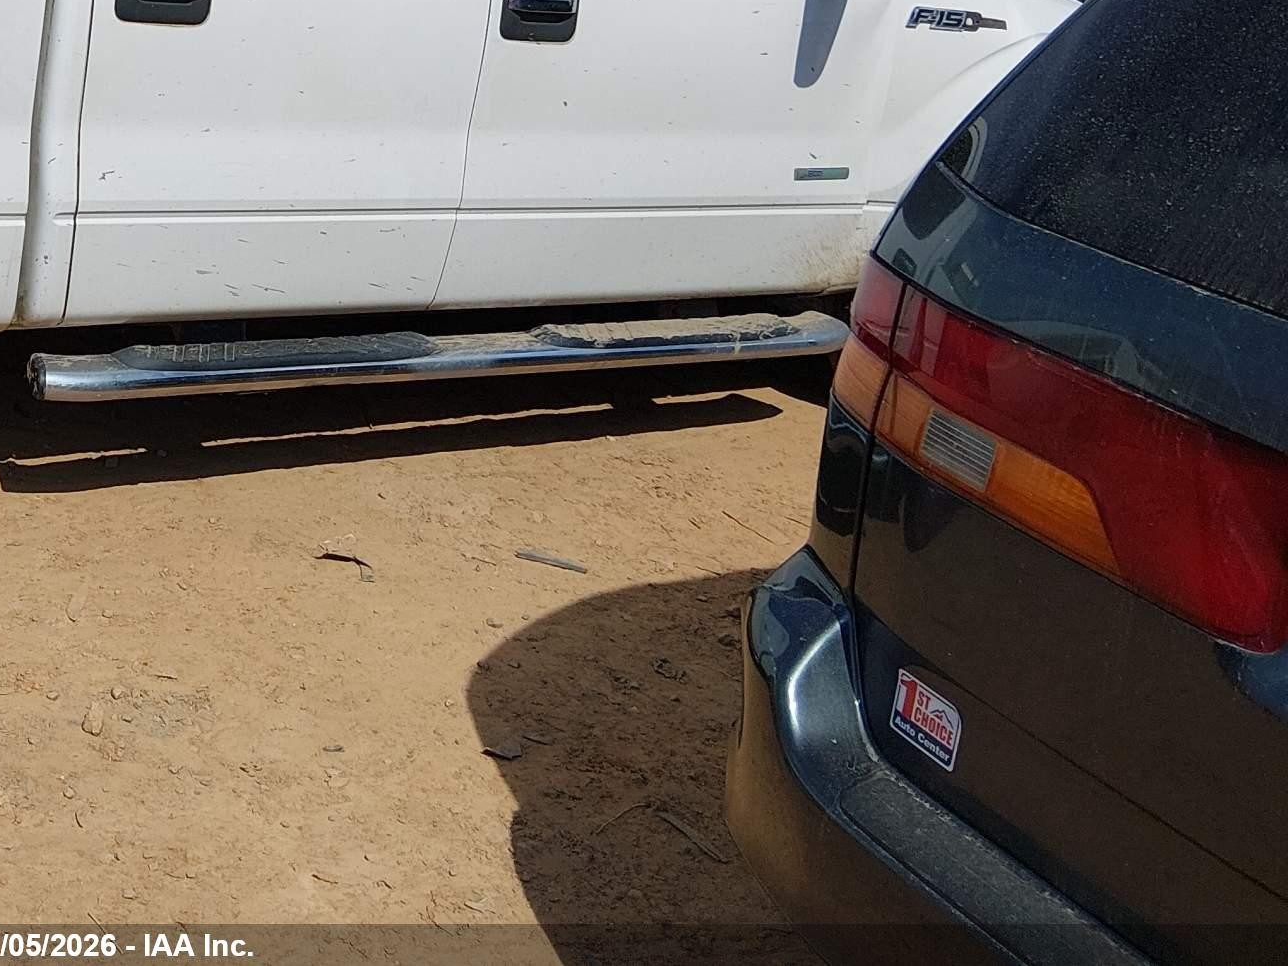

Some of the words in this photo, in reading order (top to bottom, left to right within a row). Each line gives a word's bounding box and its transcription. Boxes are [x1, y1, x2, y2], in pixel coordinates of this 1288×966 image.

[905, 6, 982, 32] F-150
[894, 716, 916, 737] Auto
[917, 733, 950, 762] Center
[914, 707, 954, 747] CHOICE
